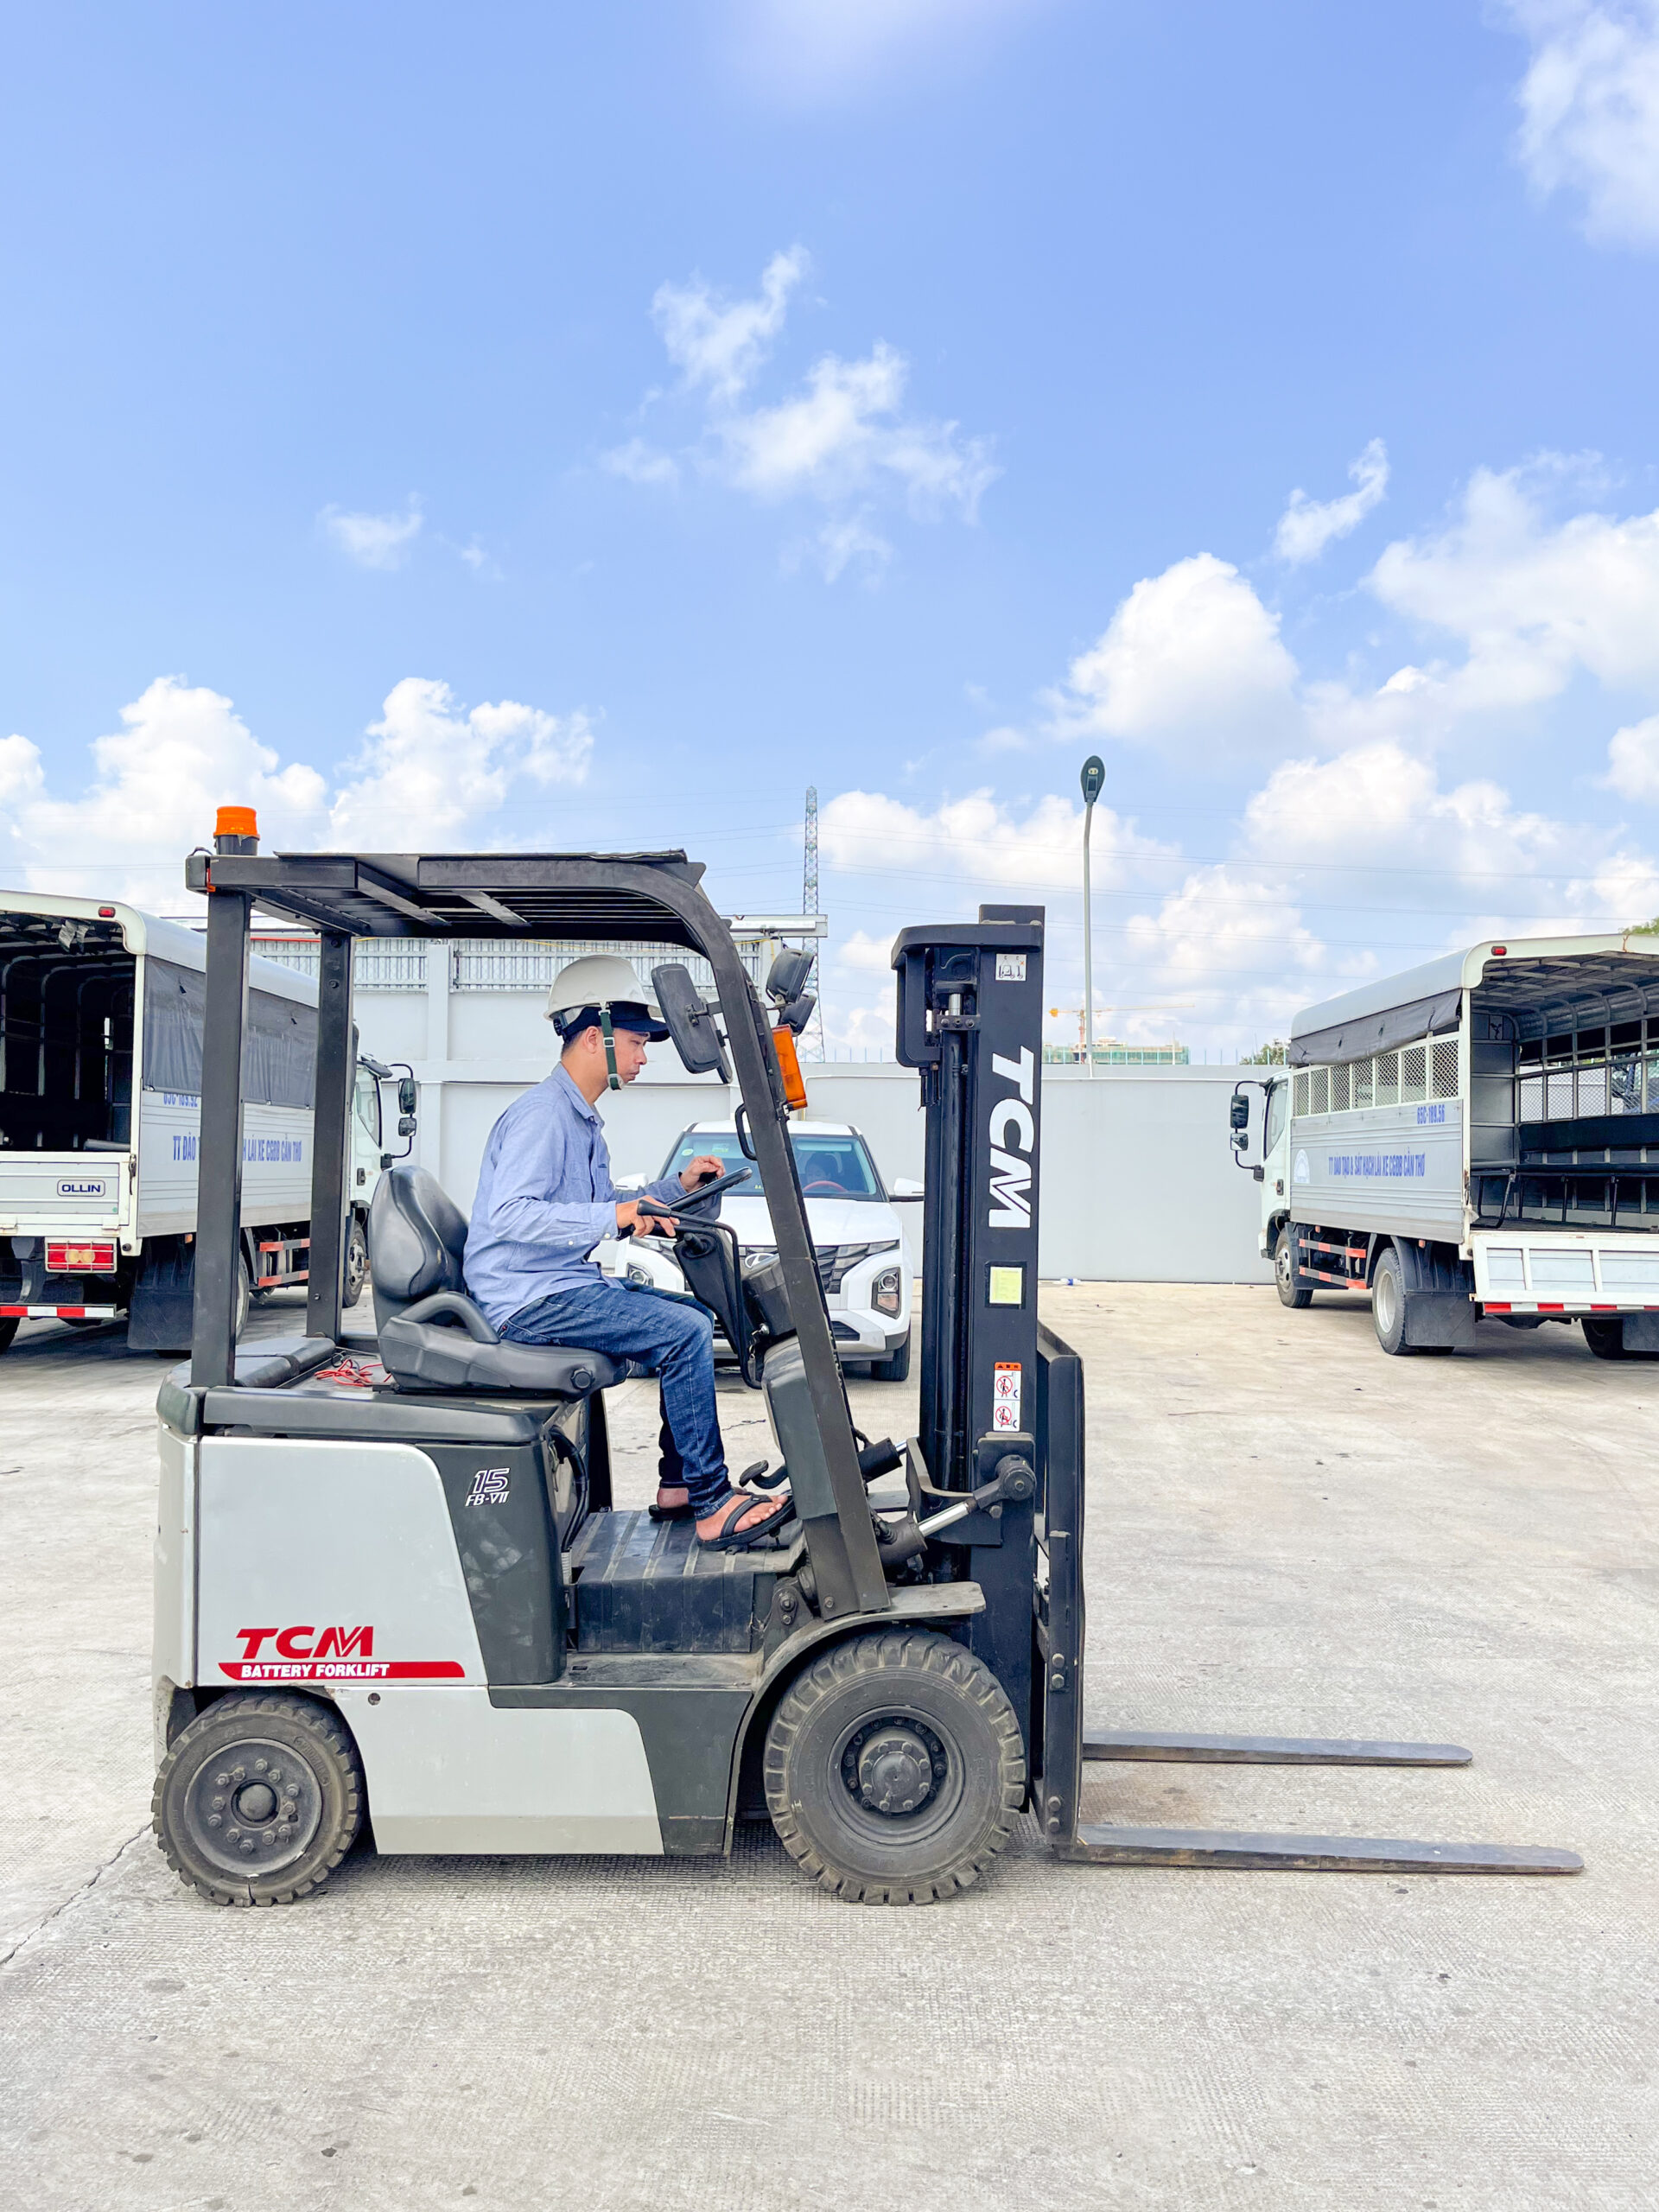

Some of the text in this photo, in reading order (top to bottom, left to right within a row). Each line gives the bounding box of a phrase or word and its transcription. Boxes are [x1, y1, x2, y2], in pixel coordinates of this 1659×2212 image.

[173, 1135, 181, 1160] TT
[988, 1046, 1034, 1228] TCM
[257, 1139, 265, 1161] XE
[1382, 1154, 1389, 1177] XE
[61, 1184, 101, 1192] OLLIN
[473, 1467, 511, 1494] 15
[236, 1626, 373, 1659] TCM
[241, 1663, 390, 1678] BATTERY FORKLIFT
